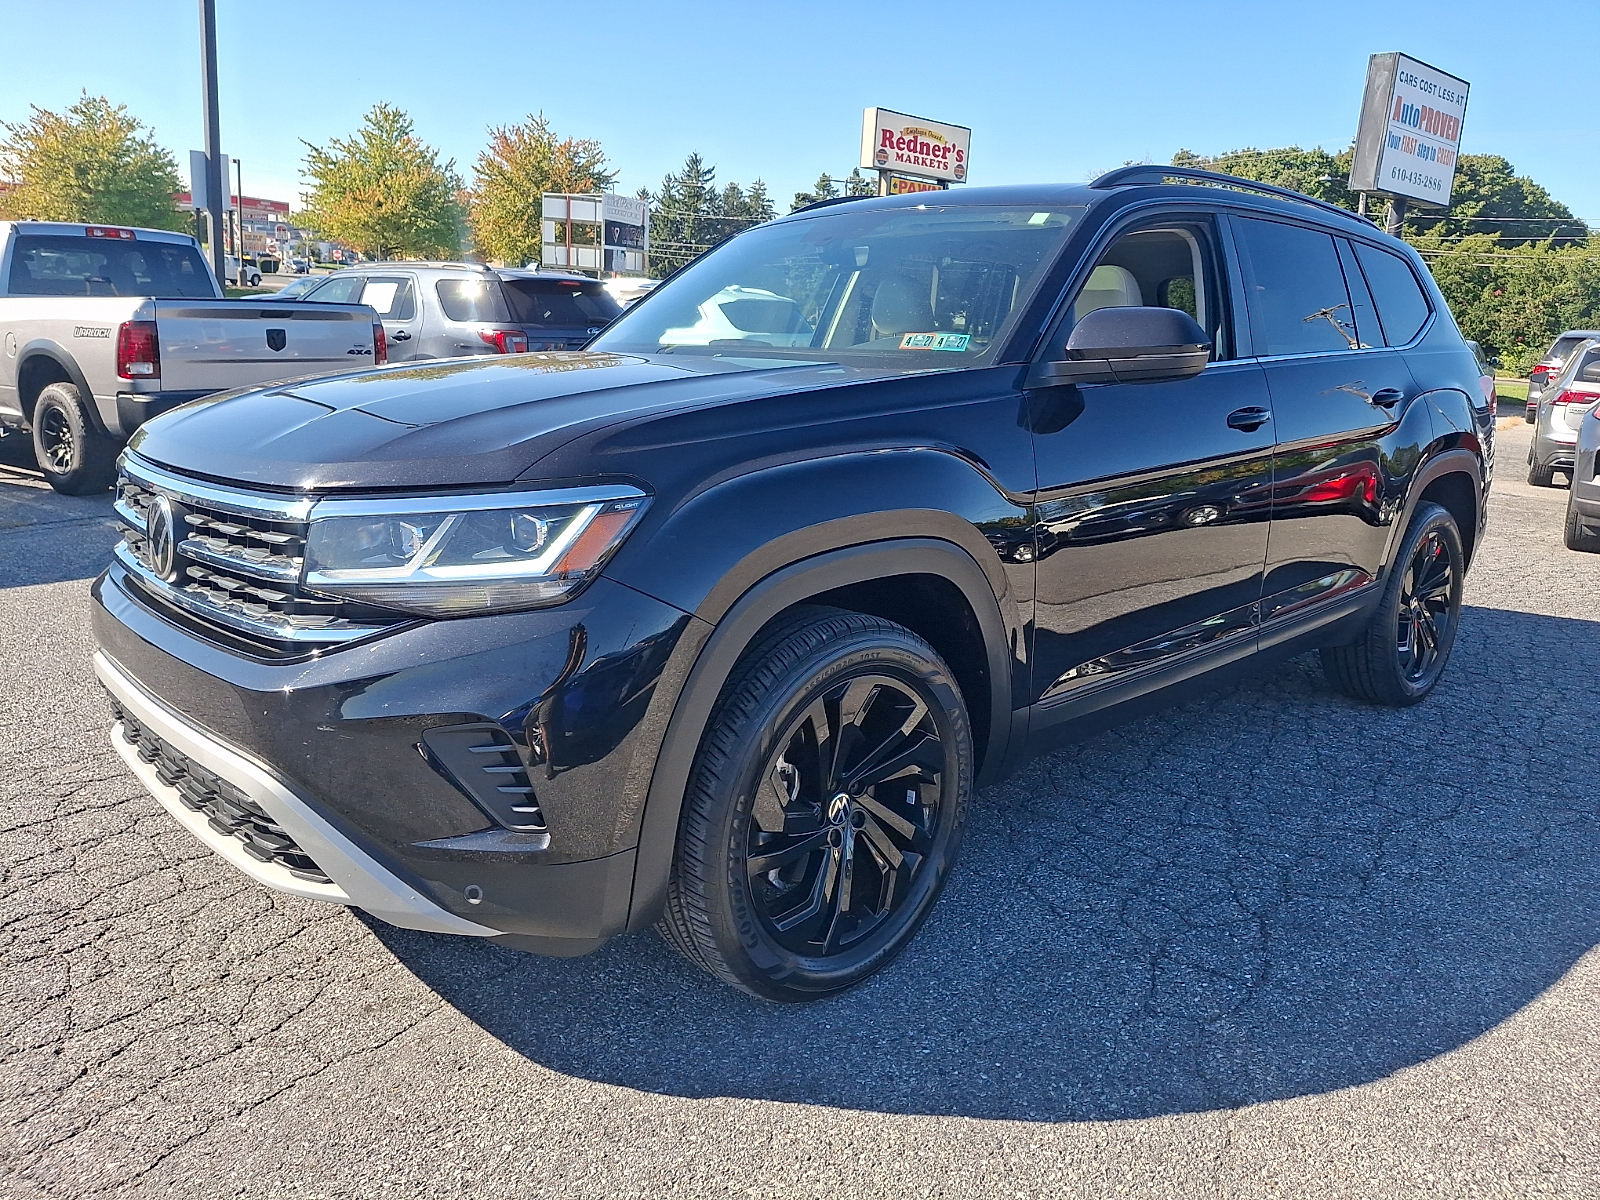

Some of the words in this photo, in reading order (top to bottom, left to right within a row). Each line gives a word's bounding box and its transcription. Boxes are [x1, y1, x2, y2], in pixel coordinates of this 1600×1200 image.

[1399, 71, 1418, 88] CARS
[1419, 79, 1437, 95] COST
[1438, 87, 1455, 102] LESS
[1455, 95, 1464, 106] AT
[1392, 95, 1460, 141] AutoPROVED
[880, 129, 964, 163] Redner's
[895, 152, 949, 170] MARKETS
[1387, 130, 1401, 150] Your
[1401, 135, 1417, 155] FIRST
[1417, 143, 1430, 161] step
[1430, 146, 1436, 161] to
[1437, 147, 1455, 167] CREDIT
[1392, 166, 1442, 191] 610-435-2886
[73, 326, 111, 338] WARLOCK
[726, 795, 759, 948] GOODYEAR
